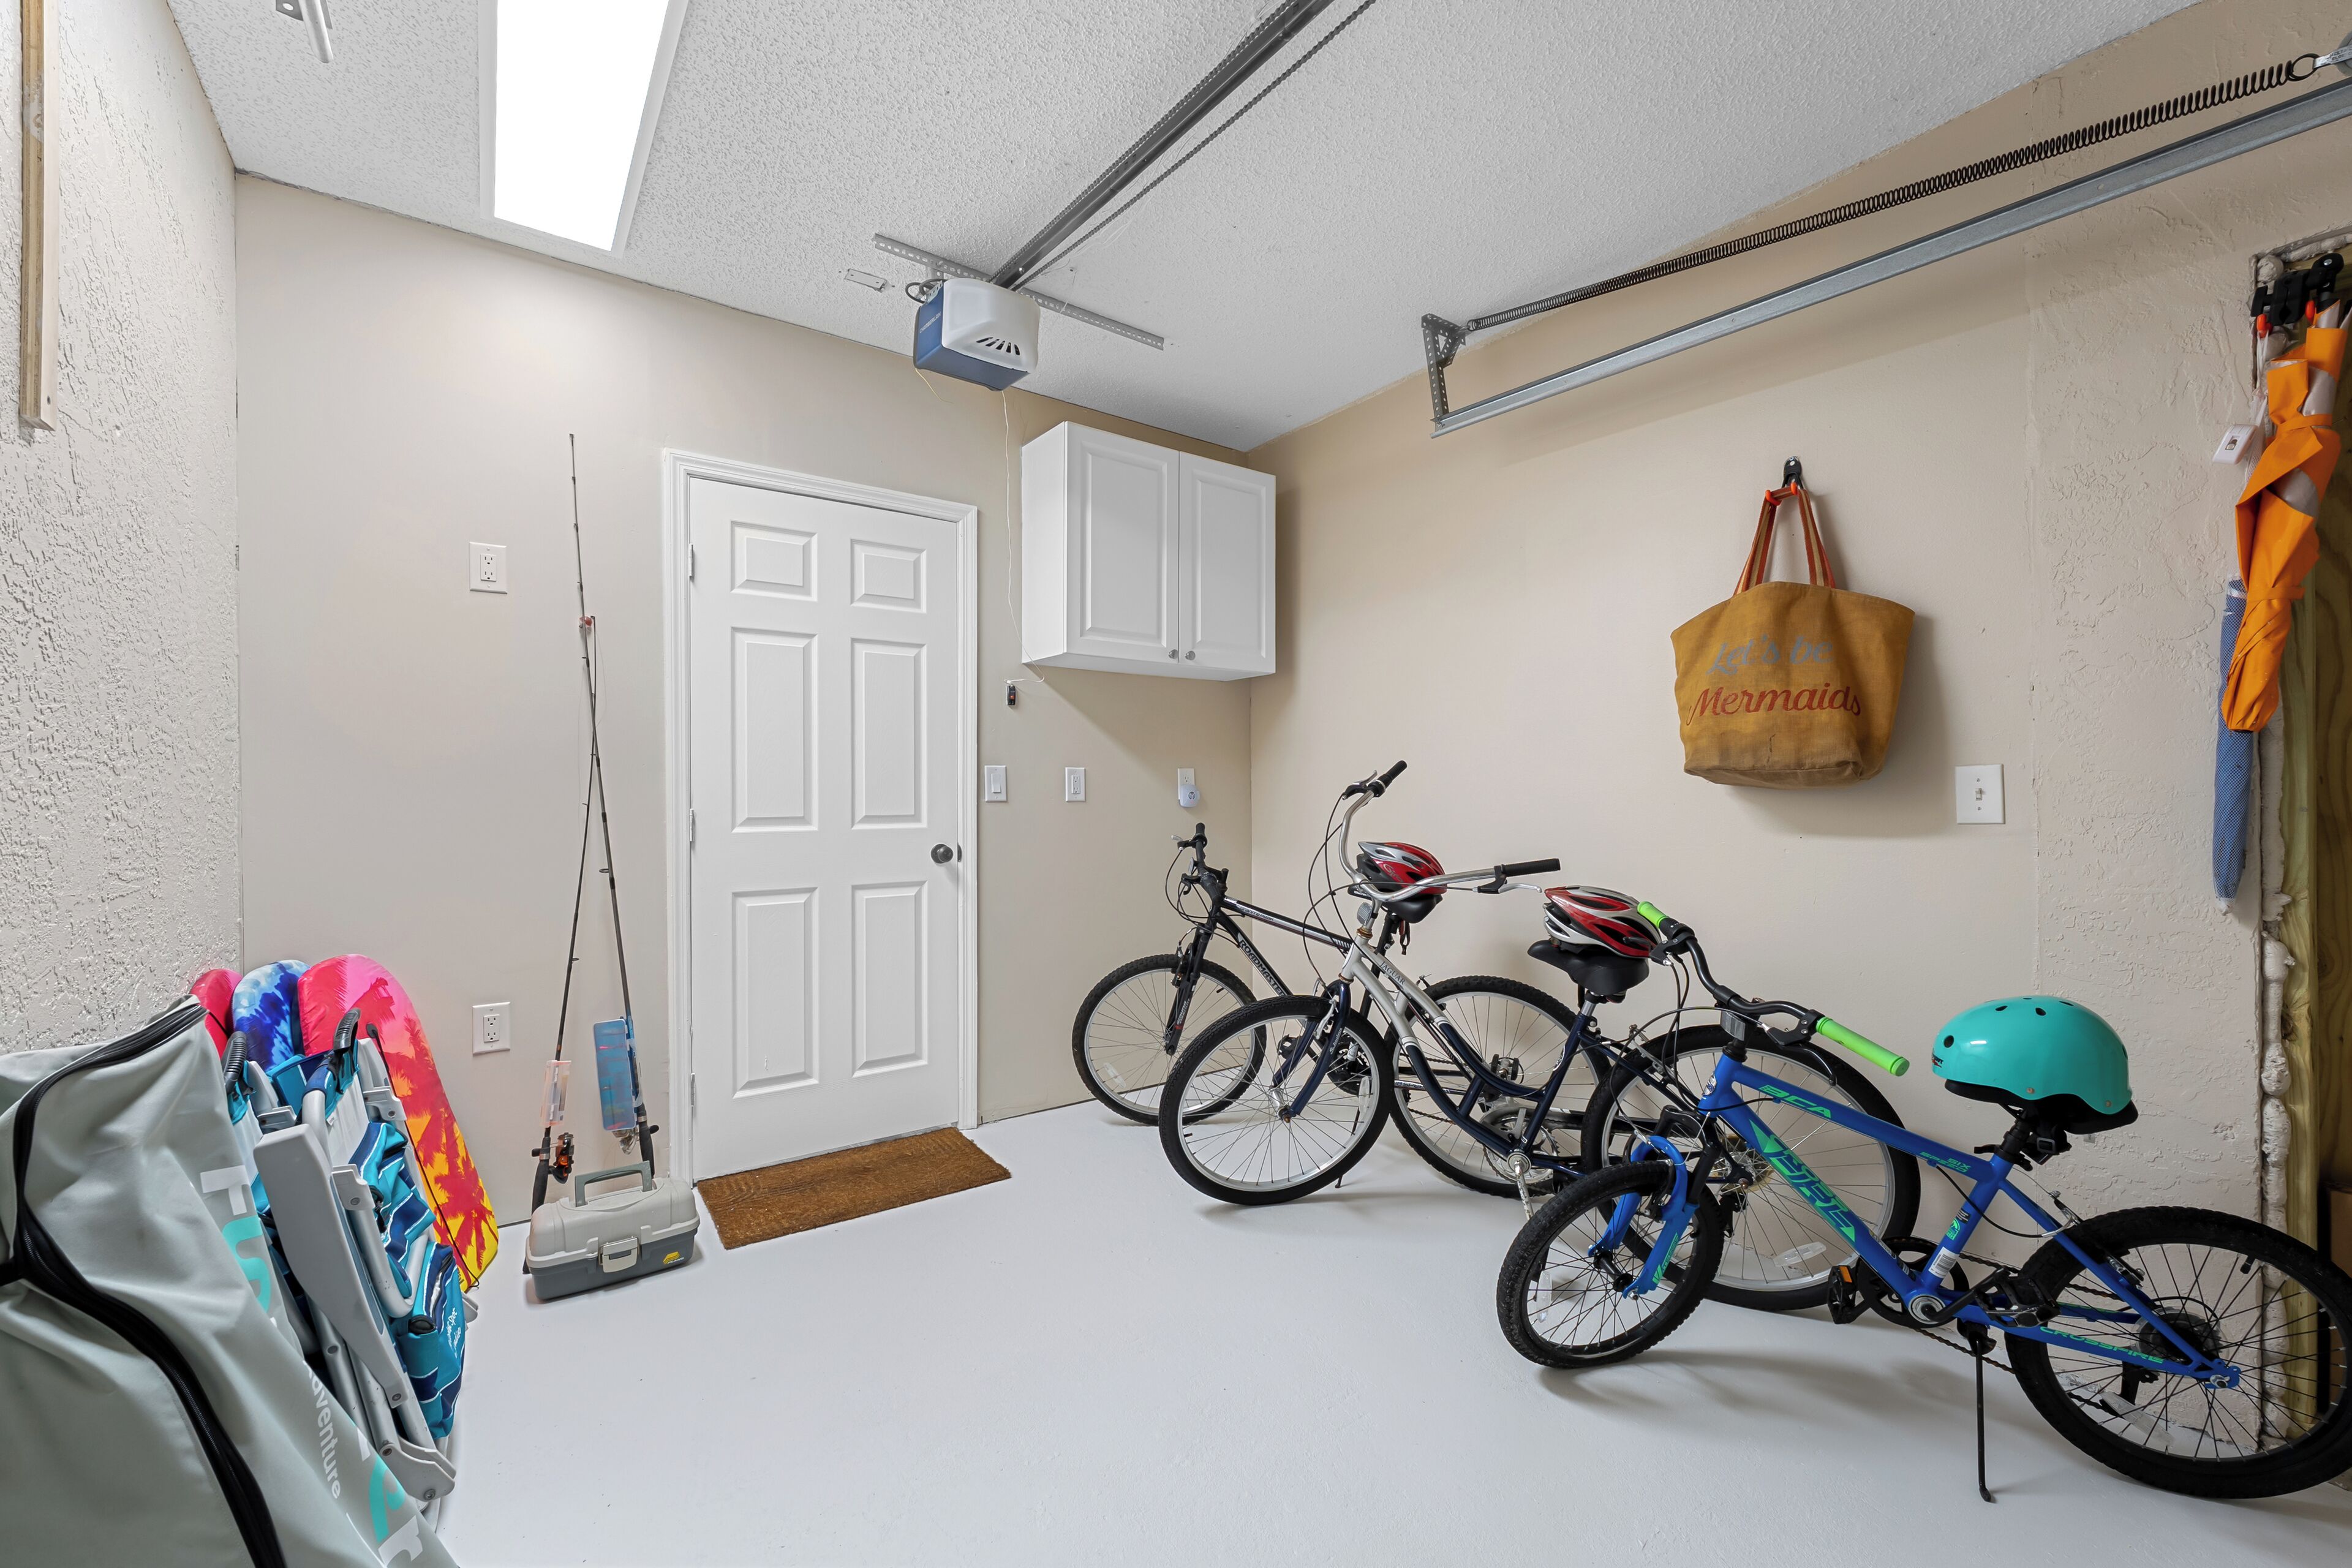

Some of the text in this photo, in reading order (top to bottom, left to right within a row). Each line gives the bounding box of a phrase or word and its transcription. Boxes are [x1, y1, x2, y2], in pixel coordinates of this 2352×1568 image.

[1705, 633, 1833, 676] Let's be
[1686, 682, 1861, 726] Mermaids
[1380, 961, 1406, 985] JAGUAR
[1758, 1084, 1831, 1118] BCA
[1920, 1152, 1968, 1173] SPEED
[1947, 1158, 1971, 1170] SIX
[2040, 1326, 2163, 1365] CROSSFIRE
